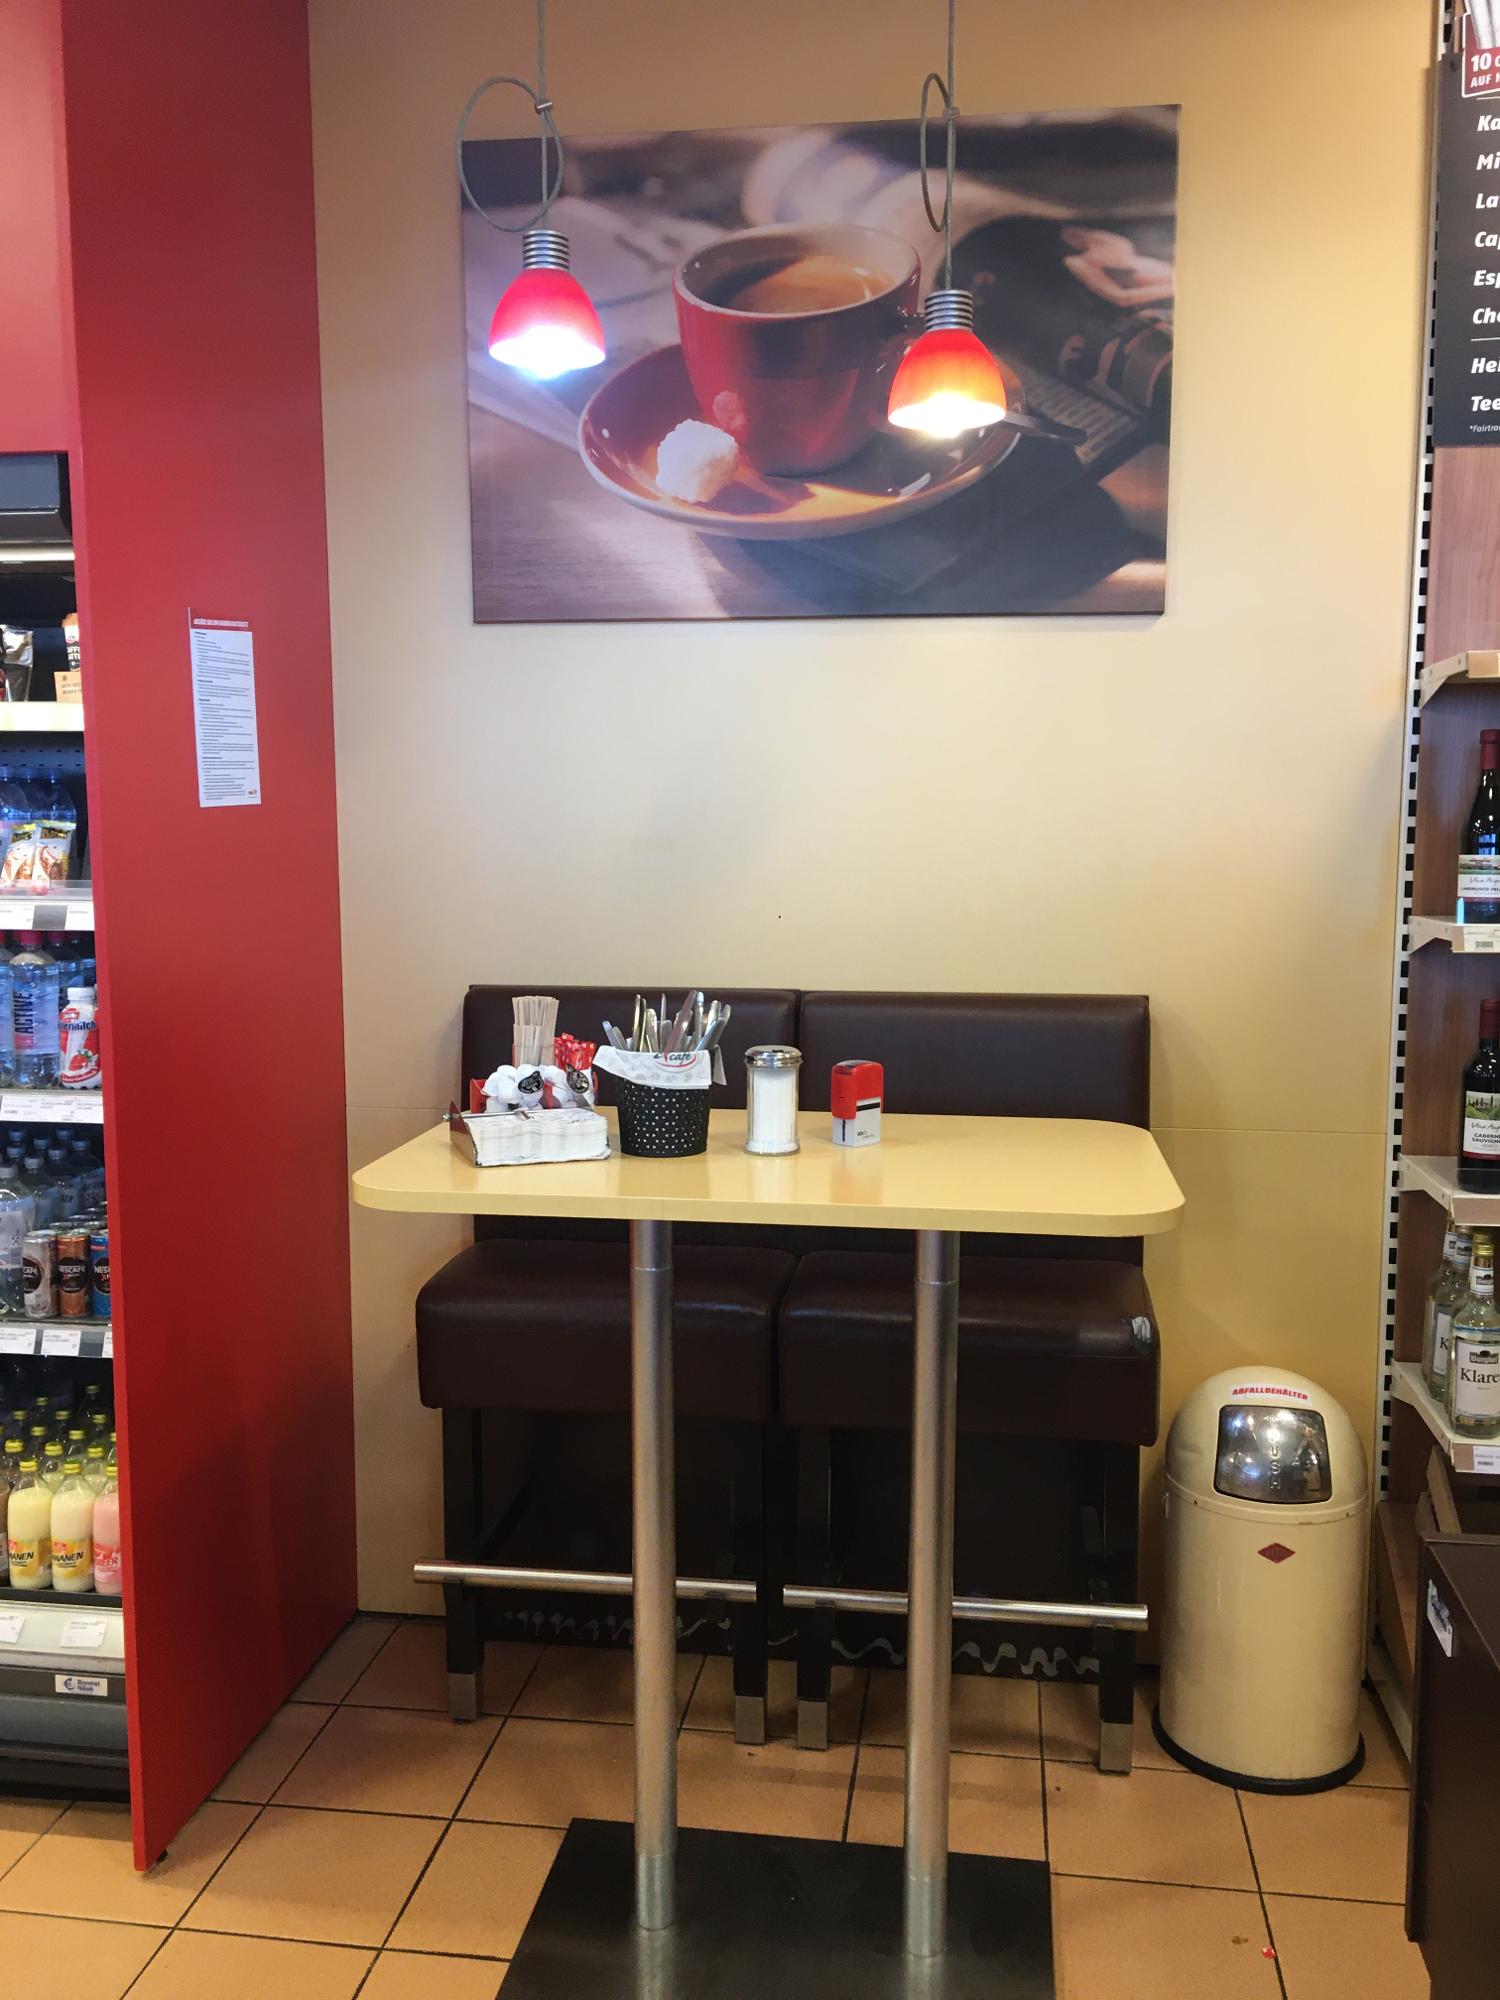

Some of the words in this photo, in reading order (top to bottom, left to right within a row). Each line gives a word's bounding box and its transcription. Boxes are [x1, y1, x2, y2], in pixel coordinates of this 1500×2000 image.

[1471, 53, 1491, 72] 10
[1470, 74, 1492, 87] AUF
[1475, 231, 1500, 249] Ca
[13, 992, 34, 1034] ACTIVE
[1232, 1387, 1308, 1400] ABFALLBEHÄLTER
